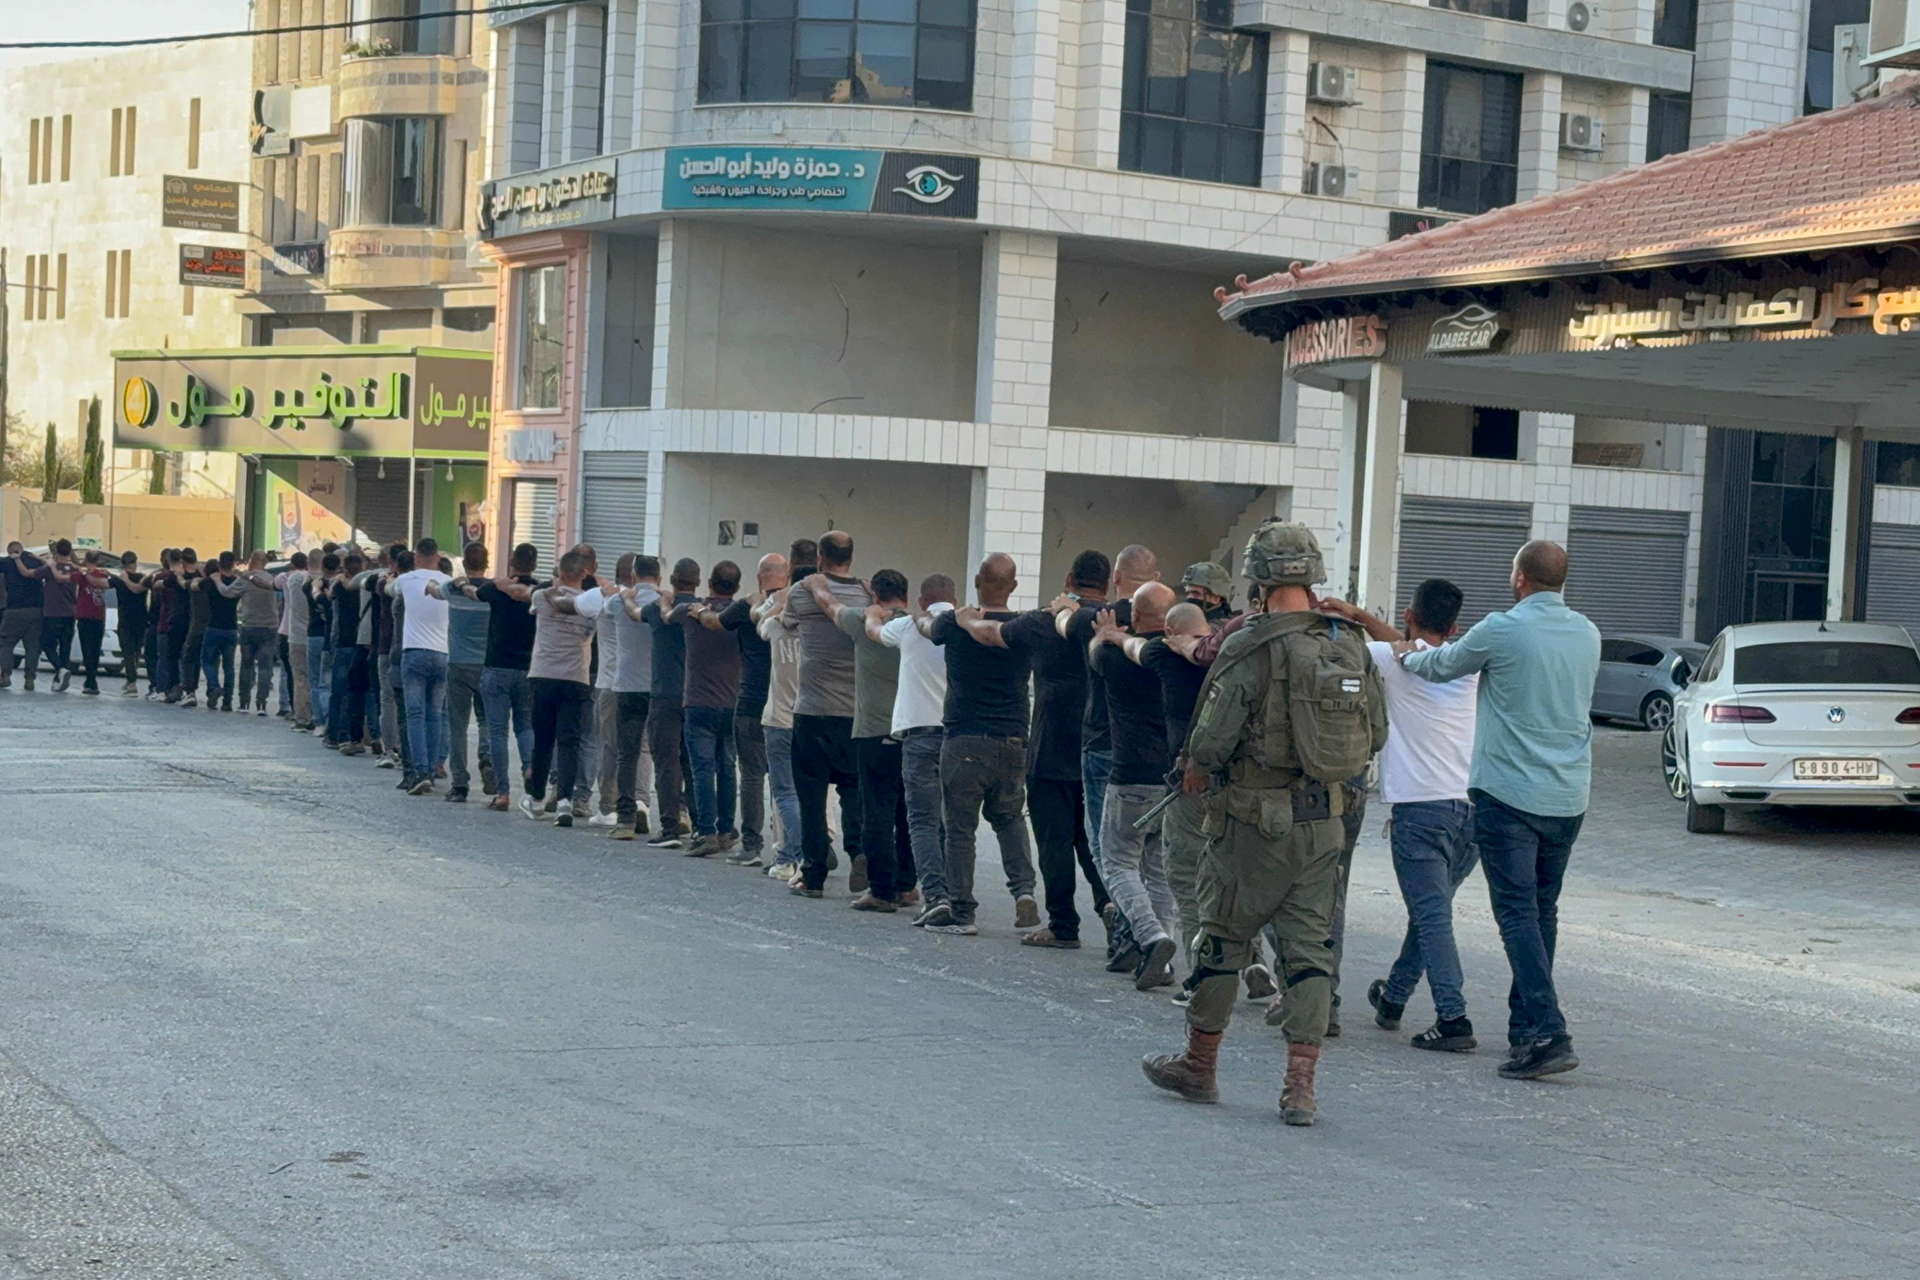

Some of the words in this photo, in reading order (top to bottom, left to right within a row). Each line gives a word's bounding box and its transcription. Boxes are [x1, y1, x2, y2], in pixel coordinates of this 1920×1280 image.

[728, 151, 751, 179] أبو
[754, 156, 790, 179] وليد
[794, 157, 840, 180] حمزة
[691, 184, 726, 197] والشبكية
[728, 184, 755, 197] العيون
[757, 184, 787, 198] وجراحة
[789, 185, 805, 197] طب
[806, 186, 846, 199] اختصاصي
[1427, 331, 1470, 351] ALDABEE
[1469, 329, 1490, 347] CAR
[165, 373, 246, 428] مول
[260, 371, 401, 429] التوفير
[420, 382, 467, 427] مول
